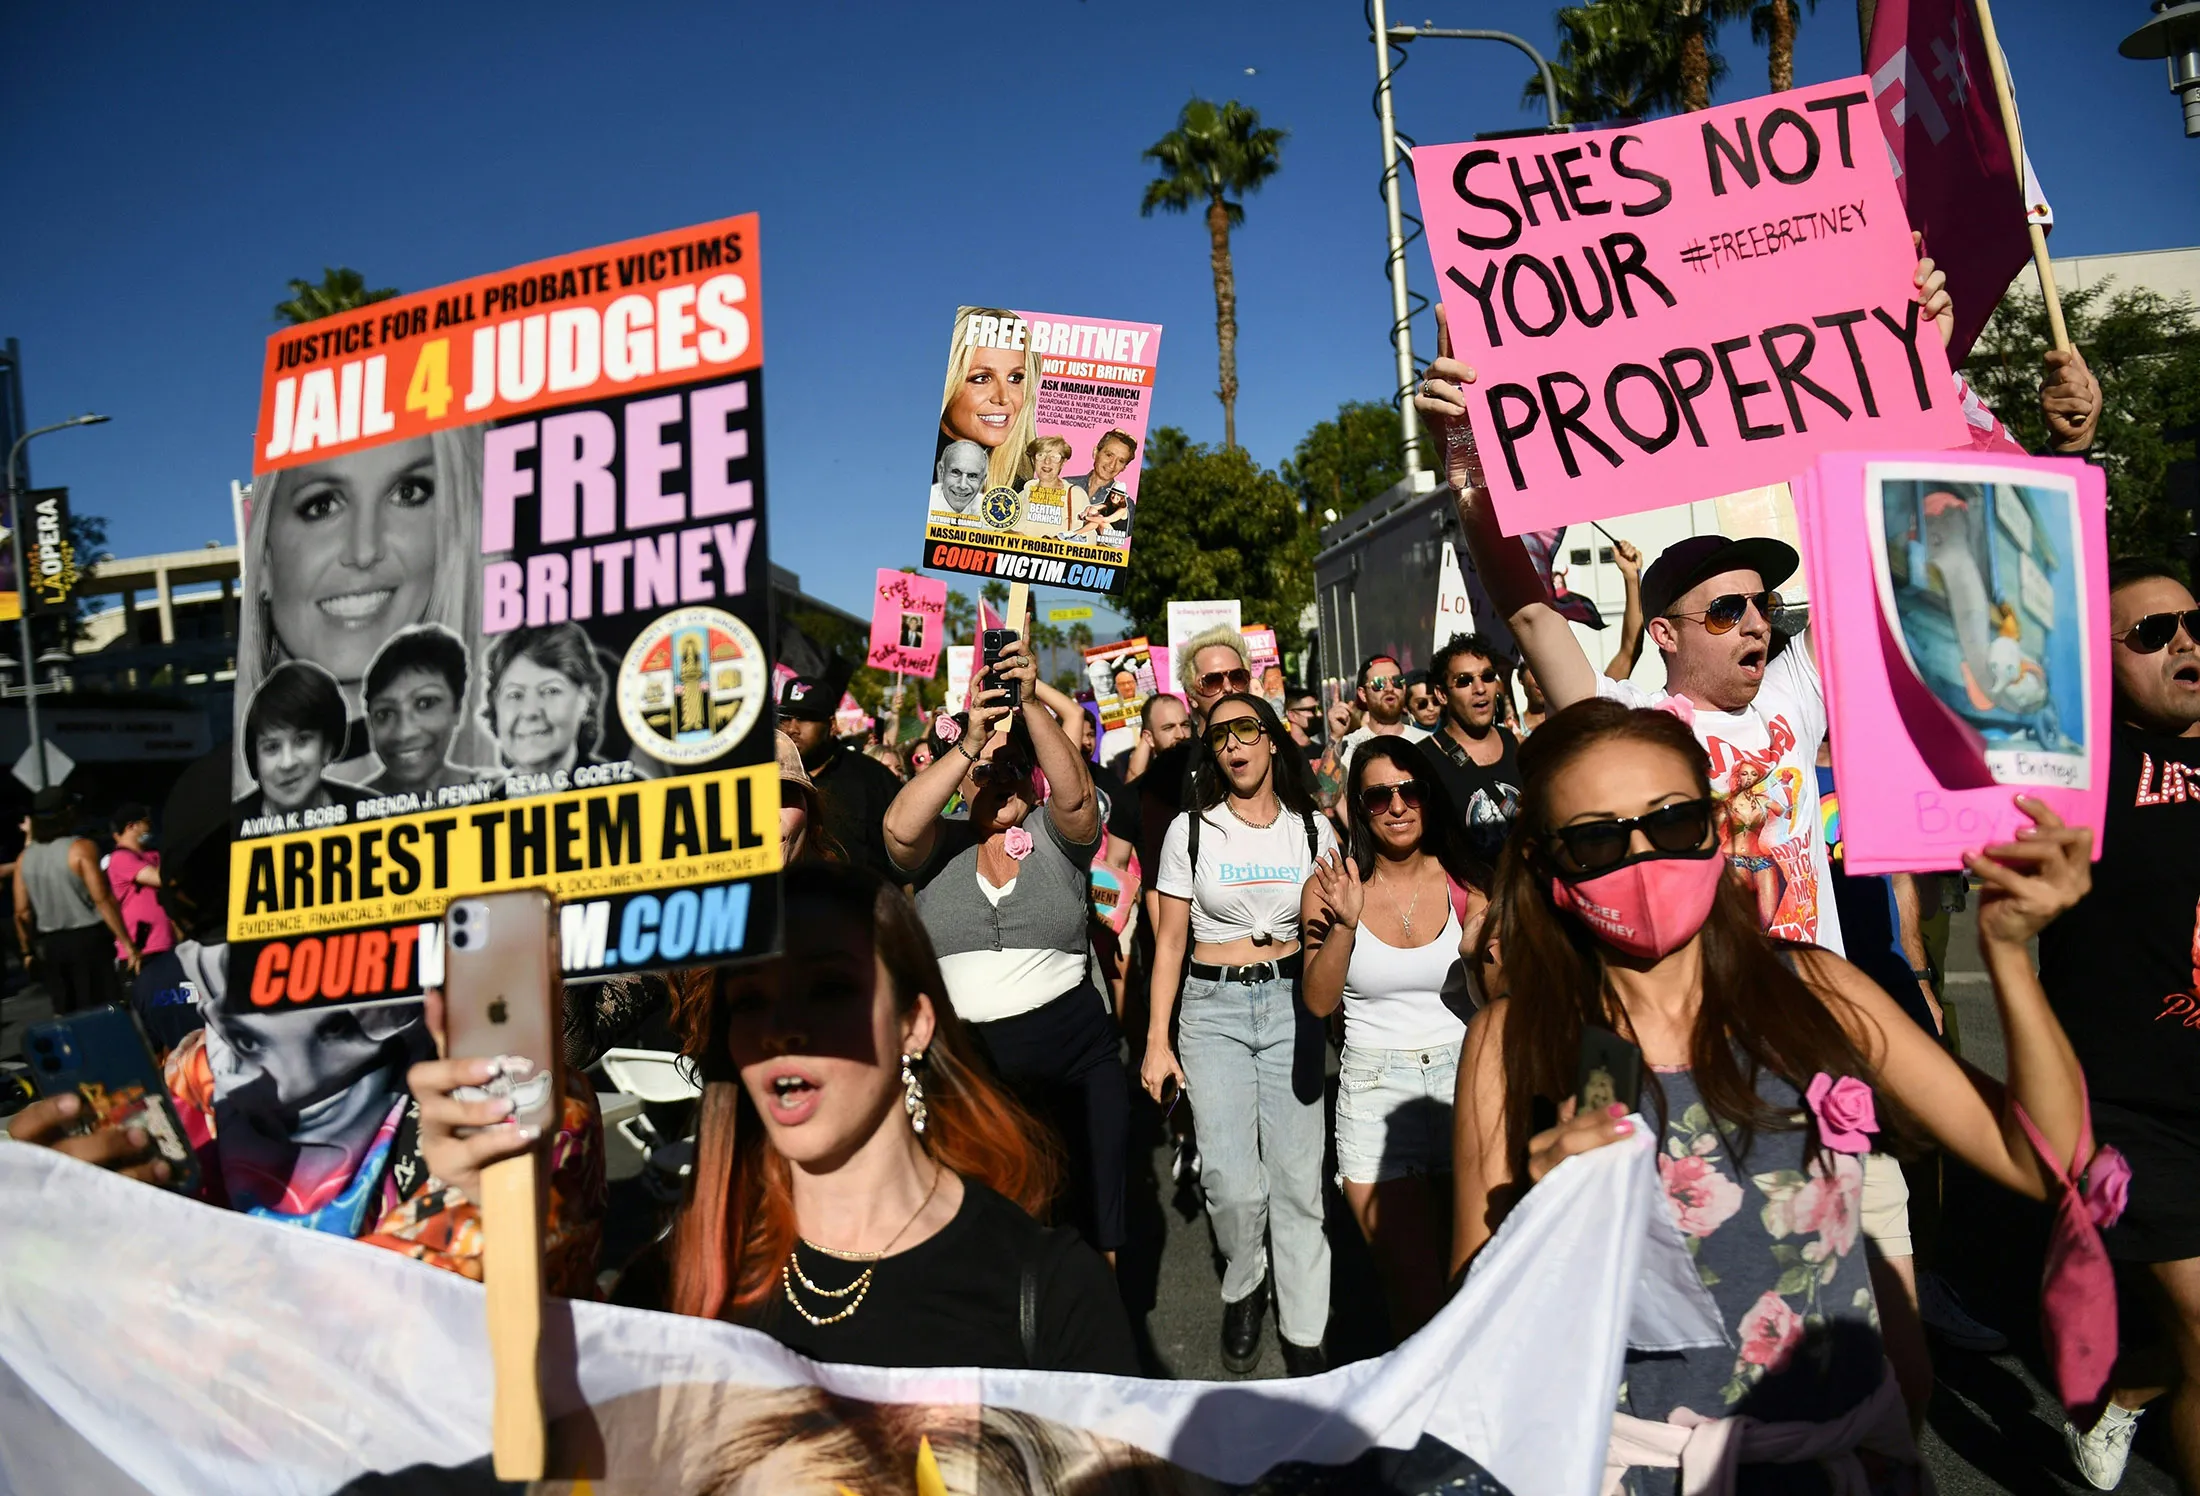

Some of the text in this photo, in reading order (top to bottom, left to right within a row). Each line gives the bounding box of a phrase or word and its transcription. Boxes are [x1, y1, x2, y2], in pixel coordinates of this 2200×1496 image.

[1452, 134, 1672, 250] SHE'S
[1700, 91, 1869, 197] NOT
[1679, 200, 1868, 274] #FREEBRITNEY
[274, 231, 744, 373] JUSTICE FOR ALL PROBATE VICTIMS
[1445, 232, 1678, 347] YOUR
[965, 314, 1150, 364] FREE BRITNEY
[265, 273, 750, 461] JAIL 4 JUDGES
[1042, 358, 1146, 383] NOT JUST BRITNEY
[1039, 397, 1070, 406] GUARDIANS
[1076, 402, 1106, 410] NUMEROUS
[1107, 405, 1133, 413] LAWYERS
[1041, 380, 1140, 400] ASK MARIAN KORNICKI
[1053, 392, 1078, 400] CHEATED
[1486, 299, 1933, 491] PROPERTY
[1049, 405, 1082, 414] LIQUIDATED
[1095, 410, 1115, 418] FAMILY
[1060, 420, 1096, 429] MISCONDUCT
[1065, 414, 1102, 423] MALPRACTICE
[481, 379, 755, 556] FREE
[1027, 512, 1062, 525] KORNICKI
[1030, 503, 1061, 516] BERTHA
[35, 497, 63, 576] OPERA
[930, 529, 1123, 563] NASSAU COUNTY NY PROBATE PREDATORS
[481, 517, 758, 636] BRITNEY
[932, 544, 1116, 590] COURTVICTIM.COM
[880, 579, 908, 601] Free
[893, 652, 935, 672] Jamie!
[304, 804, 348, 828] BOBB
[356, 792, 421, 819] BRENDA
[505, 772, 552, 796] REVA
[574, 760, 634, 787] GOETZ
[243, 775, 764, 916] ARREST THEM ALL
[1219, 862, 1300, 884] Britney
